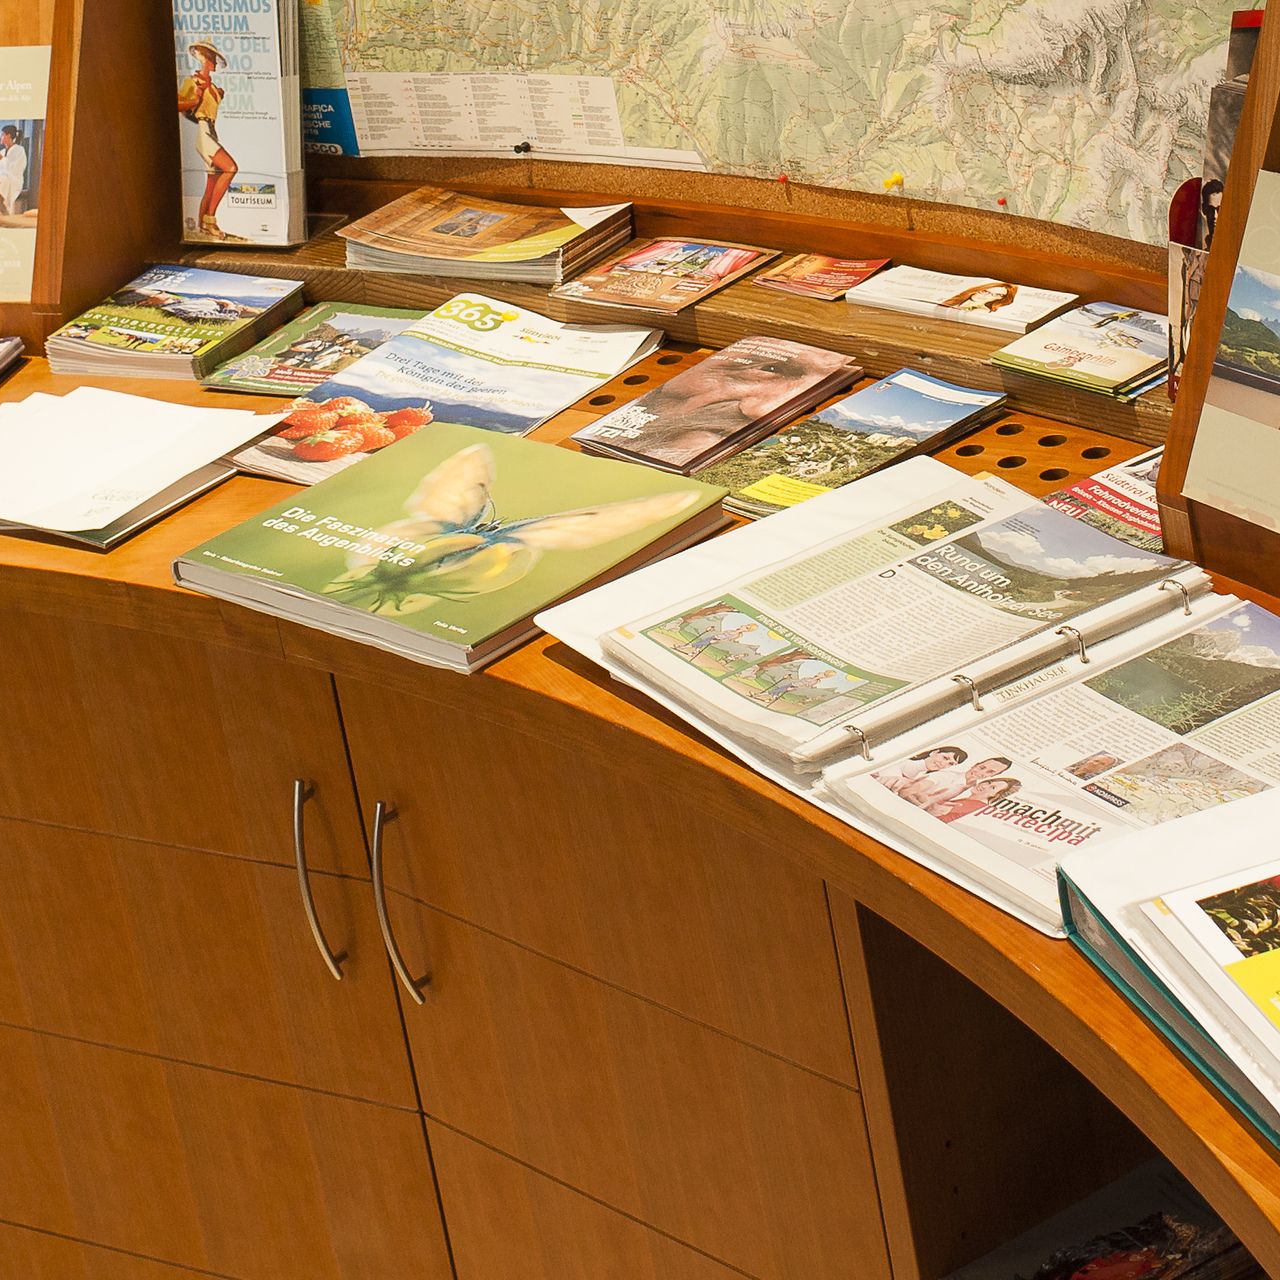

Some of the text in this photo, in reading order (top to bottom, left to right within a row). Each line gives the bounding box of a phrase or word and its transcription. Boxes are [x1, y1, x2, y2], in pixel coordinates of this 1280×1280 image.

[174, 14, 250, 32] MUSEUM
[83, 312, 225, 337] URLAUBSBEGLEITER
[438, 300, 496, 330] 365
[384, 351, 484, 387] Drei Tage mit der
[396, 365, 444, 387] Königin
[445, 378, 466, 391] der
[1048, 499, 1082, 517] NEU
[1096, 499, 1123, 515] Klausen
[262, 517, 415, 568] des Augenblicks
[281, 505, 427, 555] Die Faszination
[934, 543, 1013, 589] Rund um
[916, 554, 955, 578] den
[951, 573, 1030, 614] Antholzer
[1027, 607, 1064, 621] See
[995, 665, 1068, 701] TINKHAUSER
[973, 804, 1087, 847] partecipa
